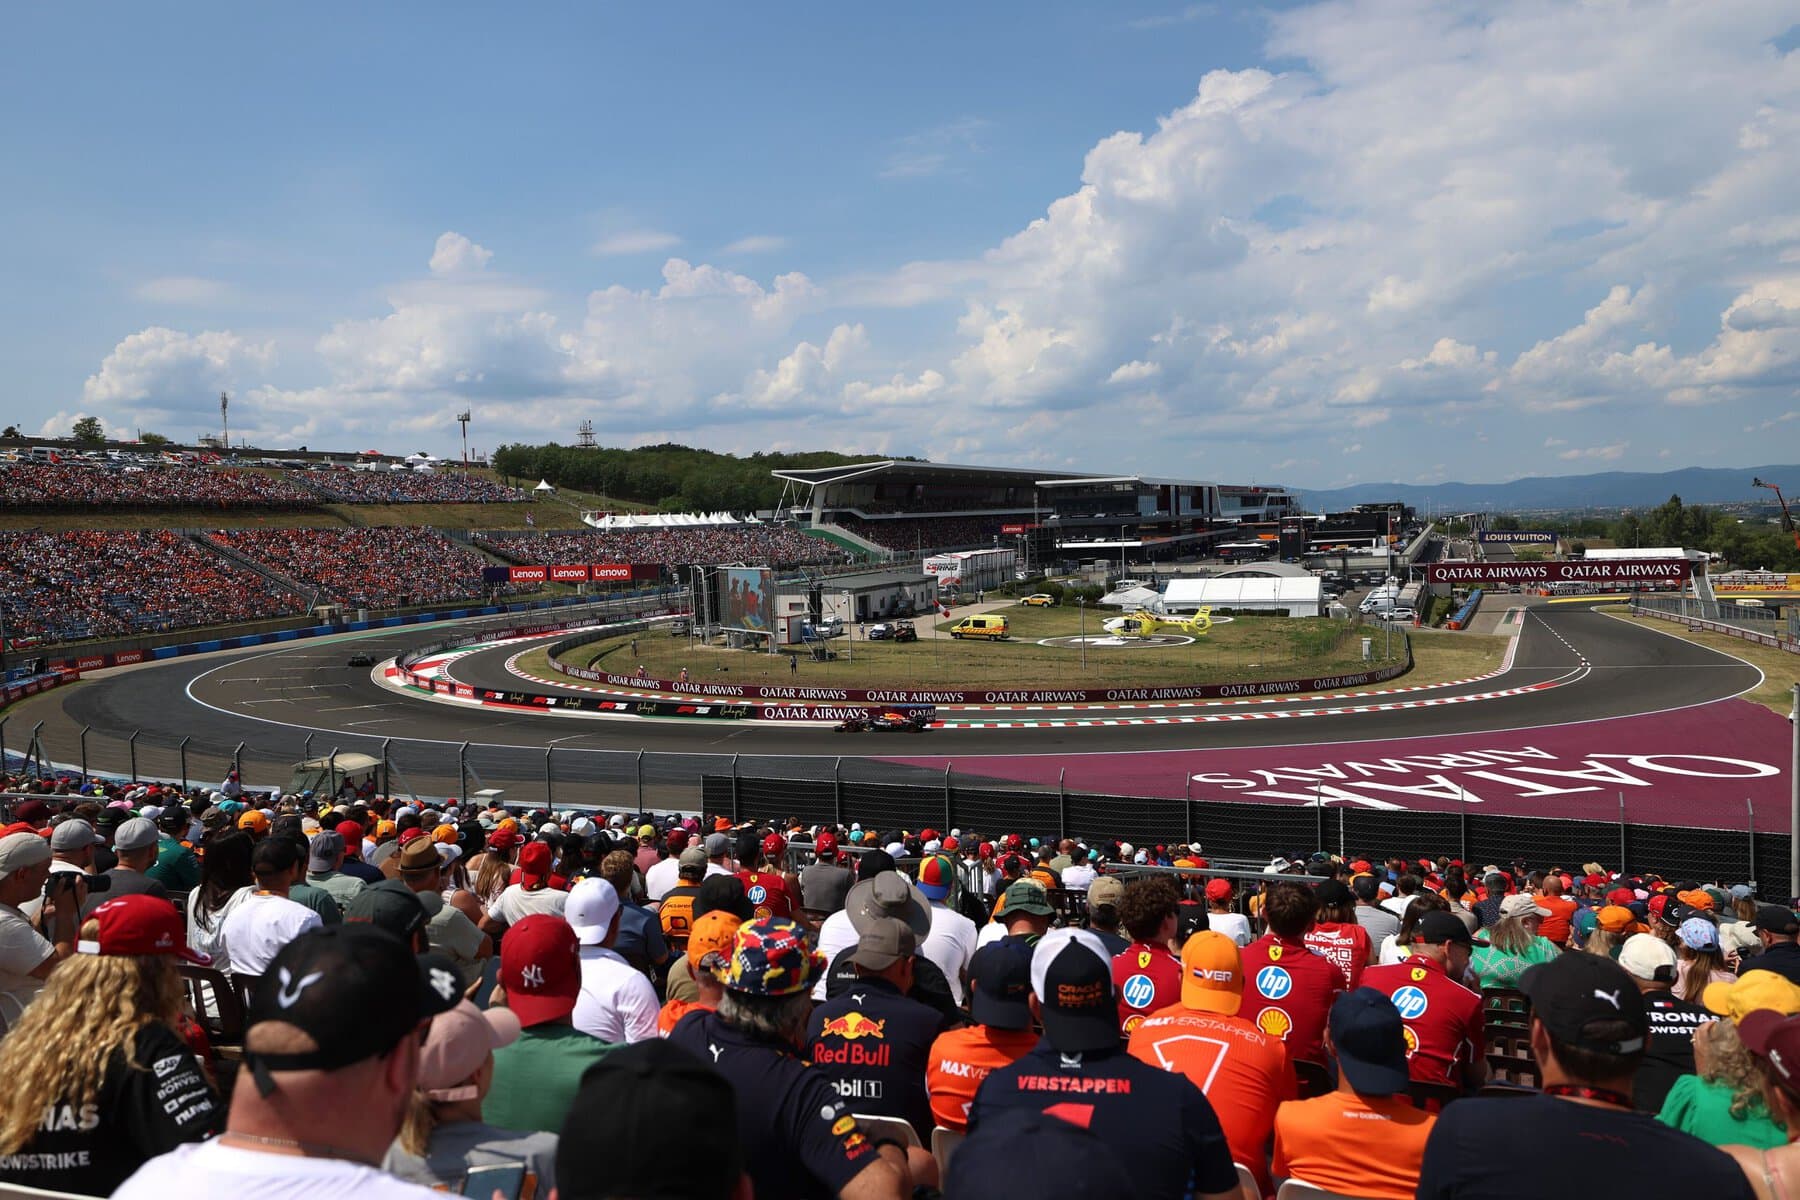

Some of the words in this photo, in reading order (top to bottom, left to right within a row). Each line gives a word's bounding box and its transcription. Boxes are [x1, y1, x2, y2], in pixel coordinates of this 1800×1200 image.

[1513, 533, 1552, 541] VUITTON
[512, 570, 544, 578] Lenovo
[553, 569, 586, 578] Lenovo
[595, 568, 628, 577] Lenovo
[1435, 568, 1482, 580] QATAR
[1486, 566, 1548, 578] AIRWAYS
[1560, 565, 1611, 578] QATAR
[1615, 564, 1681, 576] AIRWAYS
[482, 632, 497, 641] QATAR
[78, 659, 103, 668] Lenovo
[117, 653, 141, 663] Lenovo
[566, 667, 579, 677] QATAR
[580, 668, 600, 681] AIRWAYS
[608, 674, 629, 686] QATAR
[629, 677, 660, 690] AIRWAYS
[672, 682, 701, 694] QATAR
[702, 685, 744, 696] AIRWAYS
[1220, 685, 1256, 697] QATAR
[1258, 681, 1300, 694] AIRWAYS
[1314, 678, 1341, 690] QATAR
[1341, 674, 1368, 687] AIRWAYS
[456, 687, 473, 696] Lenovo
[760, 687, 796, 699] QATAR
[799, 688, 847, 700] AIRWAYS
[866, 690, 907, 702] QATAR
[910, 691, 964, 703] AIRWAYS
[985, 691, 1028, 703] QATAR
[1031, 691, 1086, 702] AIRWAYS
[1106, 689, 1148, 701] QATAR
[1151, 688, 1201, 699] AIRWAYS
[764, 707, 808, 719] QATAR
[811, 707, 869, 719] AIRWAYS
[909, 709, 935, 717] QATAR
[1192, 746, 1559, 789] AIRWAYS
[1241, 753, 1780, 810] QATAR
[750, 886, 764, 904] hp
[1203, 969, 1233, 982] VER
[1261, 966, 1289, 999] hp
[1127, 975, 1149, 1008] hp
[1394, 987, 1424, 1018] hp
[1646, 1012, 1720, 1023] RONA
[814, 1042, 849, 1064] Red
[851, 1043, 890, 1067] Bull
[154, 1056, 180, 1074] SAP
[831, 1079, 862, 1097] bil
[1018, 1075, 1131, 1094] VERSTAPPEN
[0, 1150, 91, 1170] OWDSTRIKE
